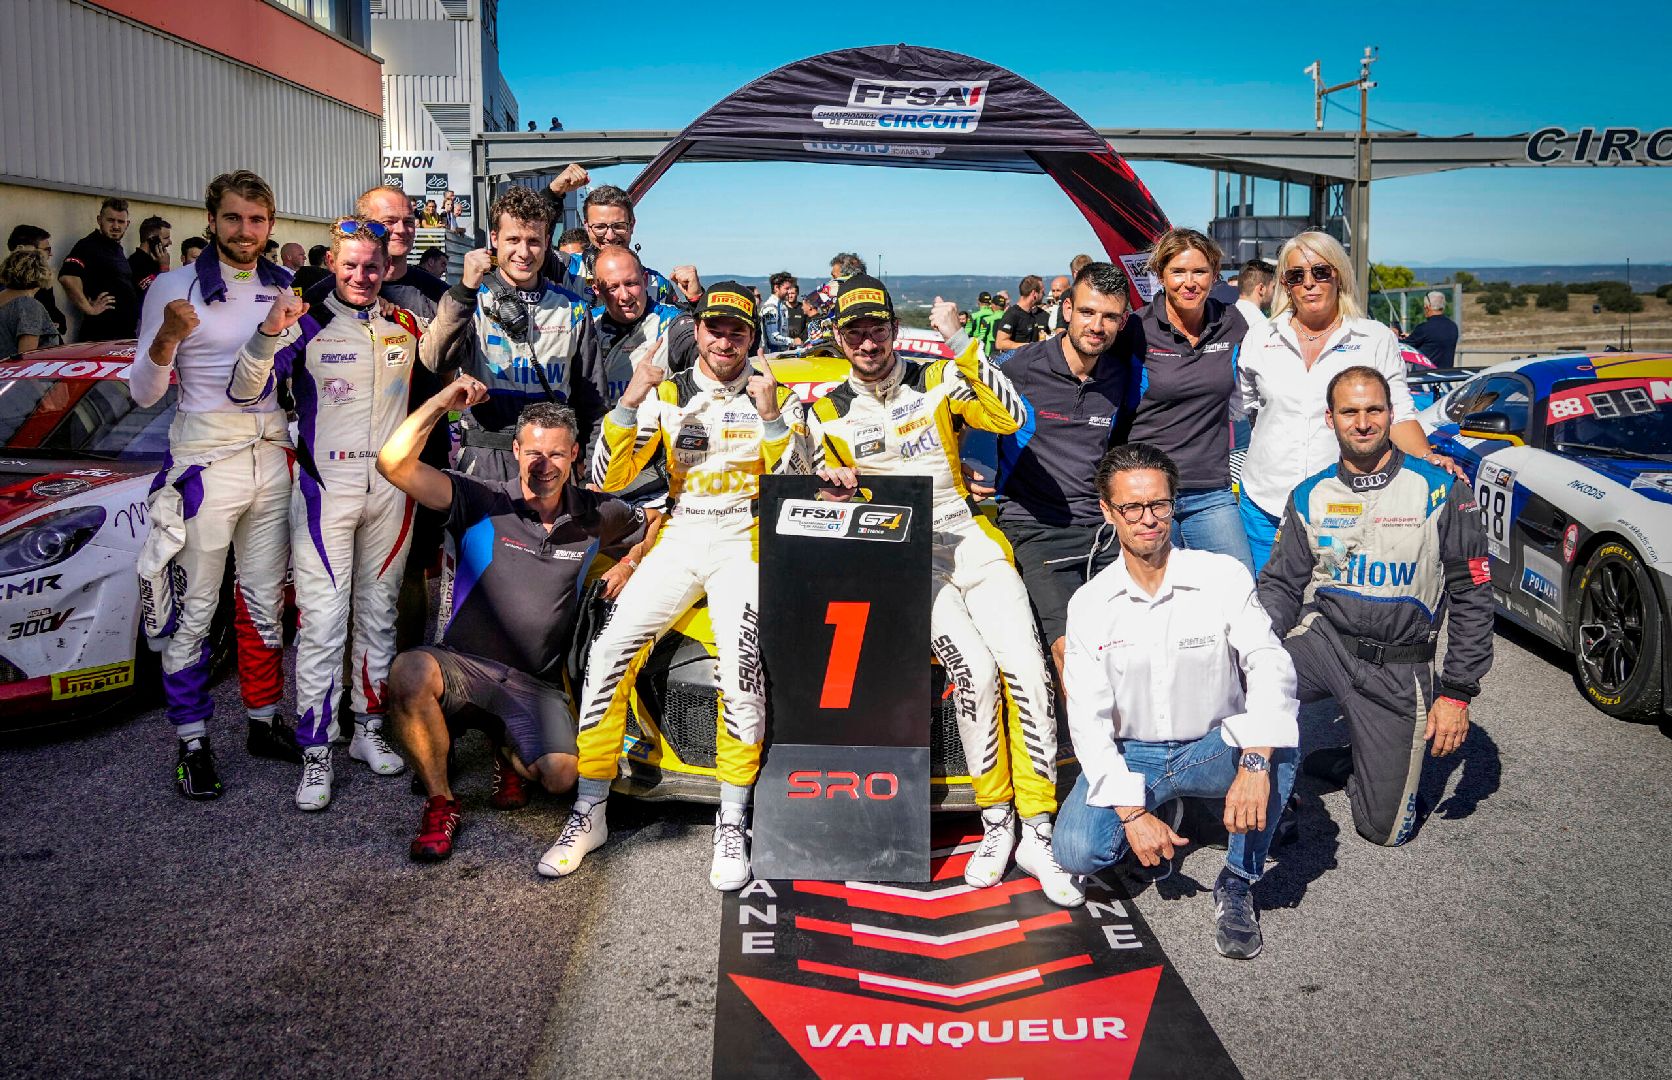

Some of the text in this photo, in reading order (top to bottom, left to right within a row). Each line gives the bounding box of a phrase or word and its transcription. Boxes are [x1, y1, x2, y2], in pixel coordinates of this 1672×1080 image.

[854, 85, 967, 106] FFSA
[817, 111, 878, 120] CHAMPIONNAT
[842, 119, 876, 127] FRANCE
[878, 114, 974, 129] CIRCUIT
[841, 290, 883, 309] PIRELLI
[1549, 398, 1585, 419] 88
[791, 508, 839, 520] FFSA
[859, 511, 903, 530] GT4
[1480, 484, 1505, 541] 88
[1347, 552, 1417, 587] flow
[0, 574, 63, 600] MR
[7, 607, 76, 640] 300V
[819, 602, 871, 709] 1
[60, 666, 131, 695] PIRELLI
[788, 770, 899, 800] SRO
[805, 1016, 1129, 1048] VAINQUEUR
